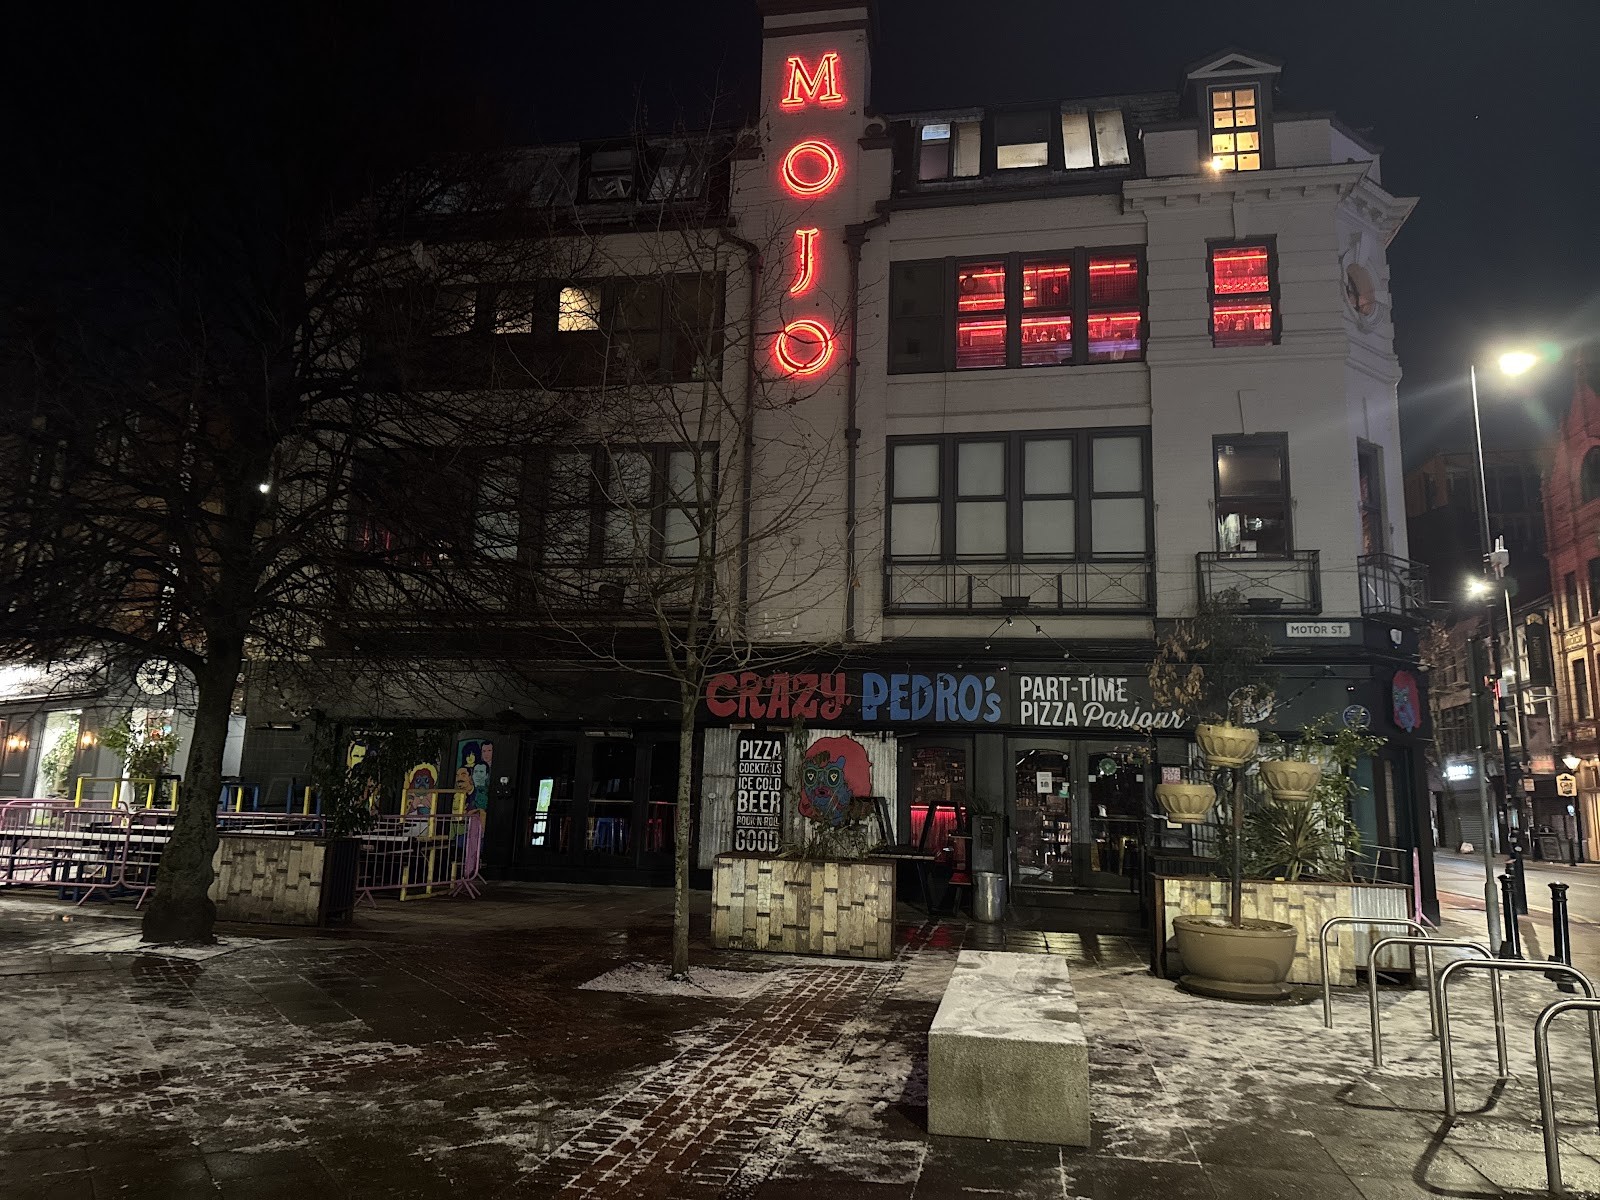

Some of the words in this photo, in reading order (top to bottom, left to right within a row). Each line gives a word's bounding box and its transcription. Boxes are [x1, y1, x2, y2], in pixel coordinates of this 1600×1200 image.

[775, 53, 843, 375] MOJO
[1291, 625, 1328, 634] MOTOR
[1331, 625, 1346, 634] ST.
[705, 672, 850, 720] CRAZY
[1020, 675, 1129, 702] PART-TIME
[1020, 701, 1078, 727] PIZZA
[1082, 702, 1186, 729] Parlour
[740, 740, 782, 760] PIZZA
[739, 762, 782, 774] COCKTALS
[739, 776, 754, 790] ICE
[755, 777, 781, 791] COLD
[737, 790, 781, 813] BEER
[735, 829, 779, 852] GOOD
